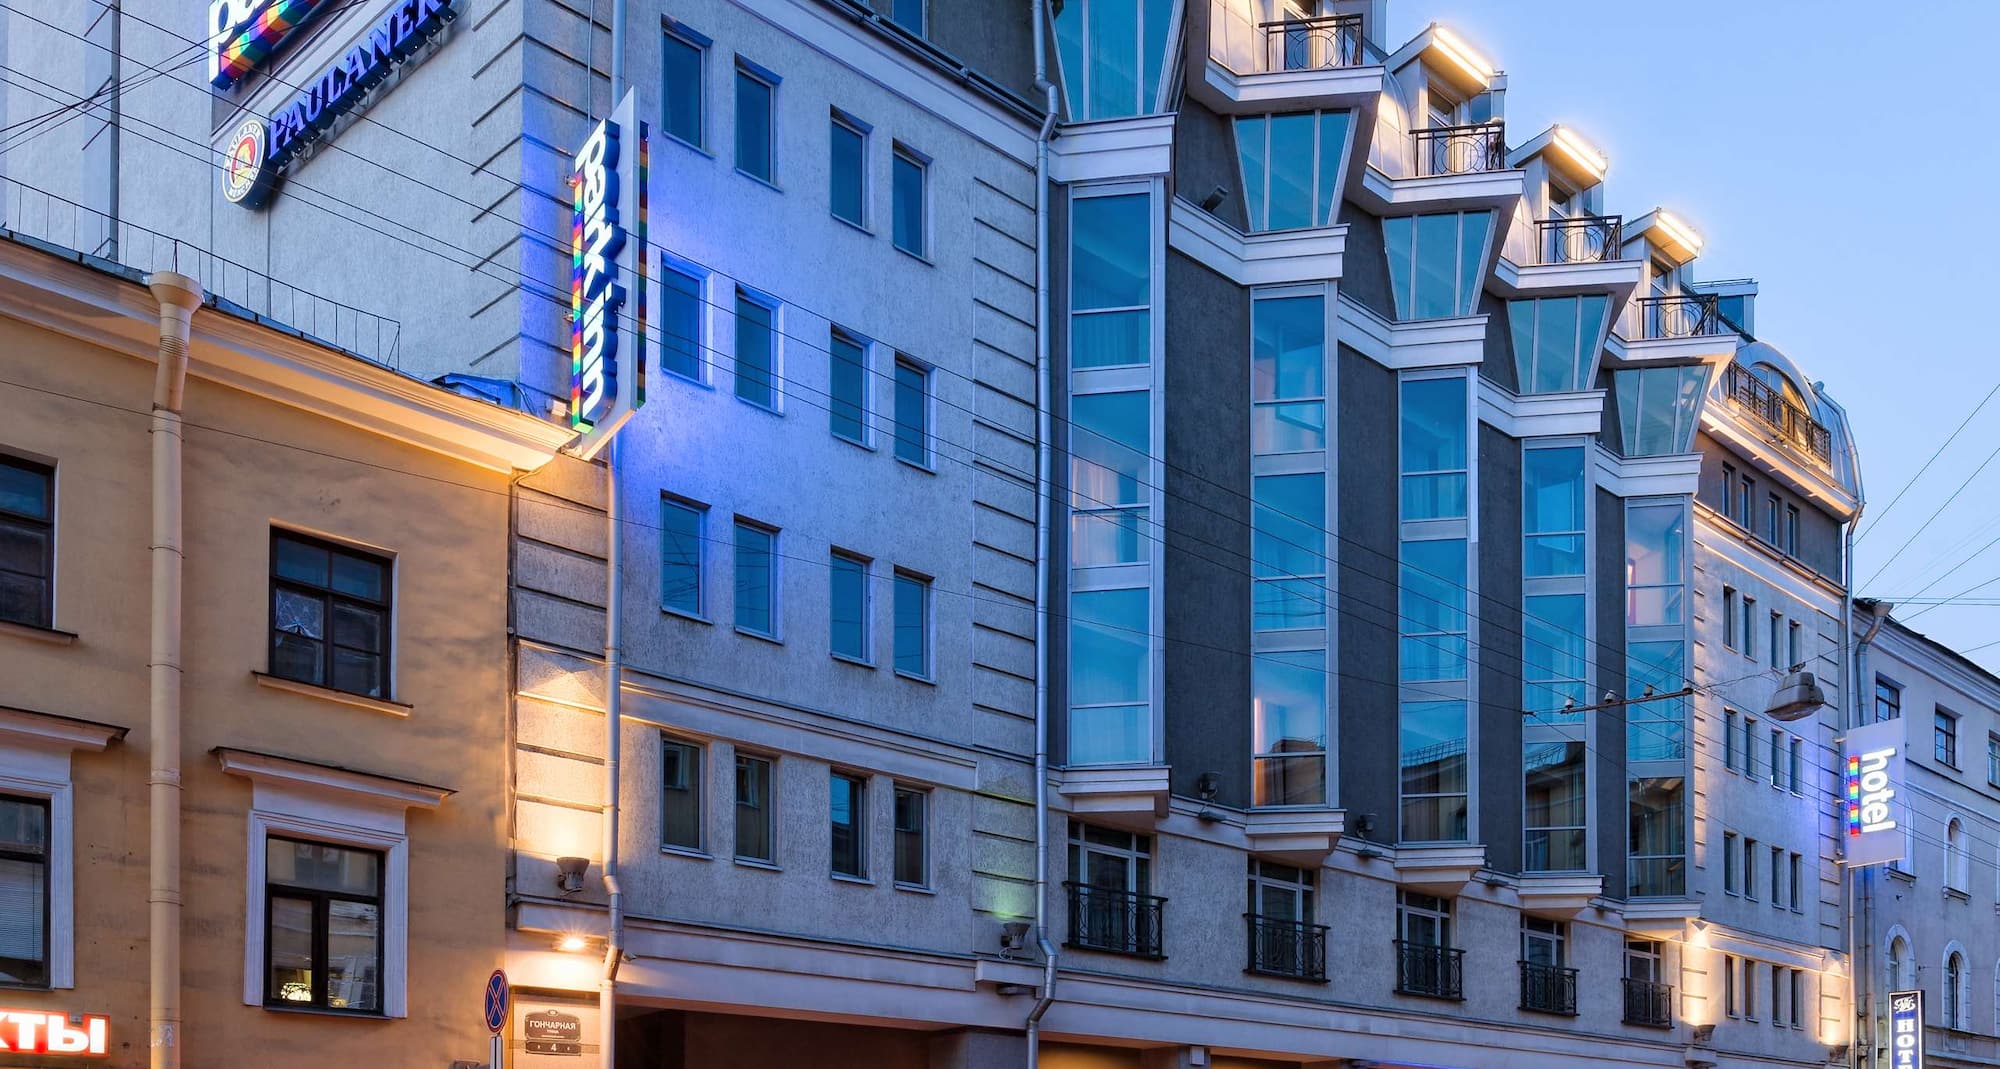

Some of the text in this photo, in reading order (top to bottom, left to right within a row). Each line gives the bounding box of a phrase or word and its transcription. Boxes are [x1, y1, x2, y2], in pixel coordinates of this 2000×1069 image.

[575, 118, 612, 419] park inn
[1861, 748, 1897, 833] hotel
[0, 1011, 105, 1054] ТЫ
[529, 1020, 576, 1030] ГОНЧАРНАЯ
